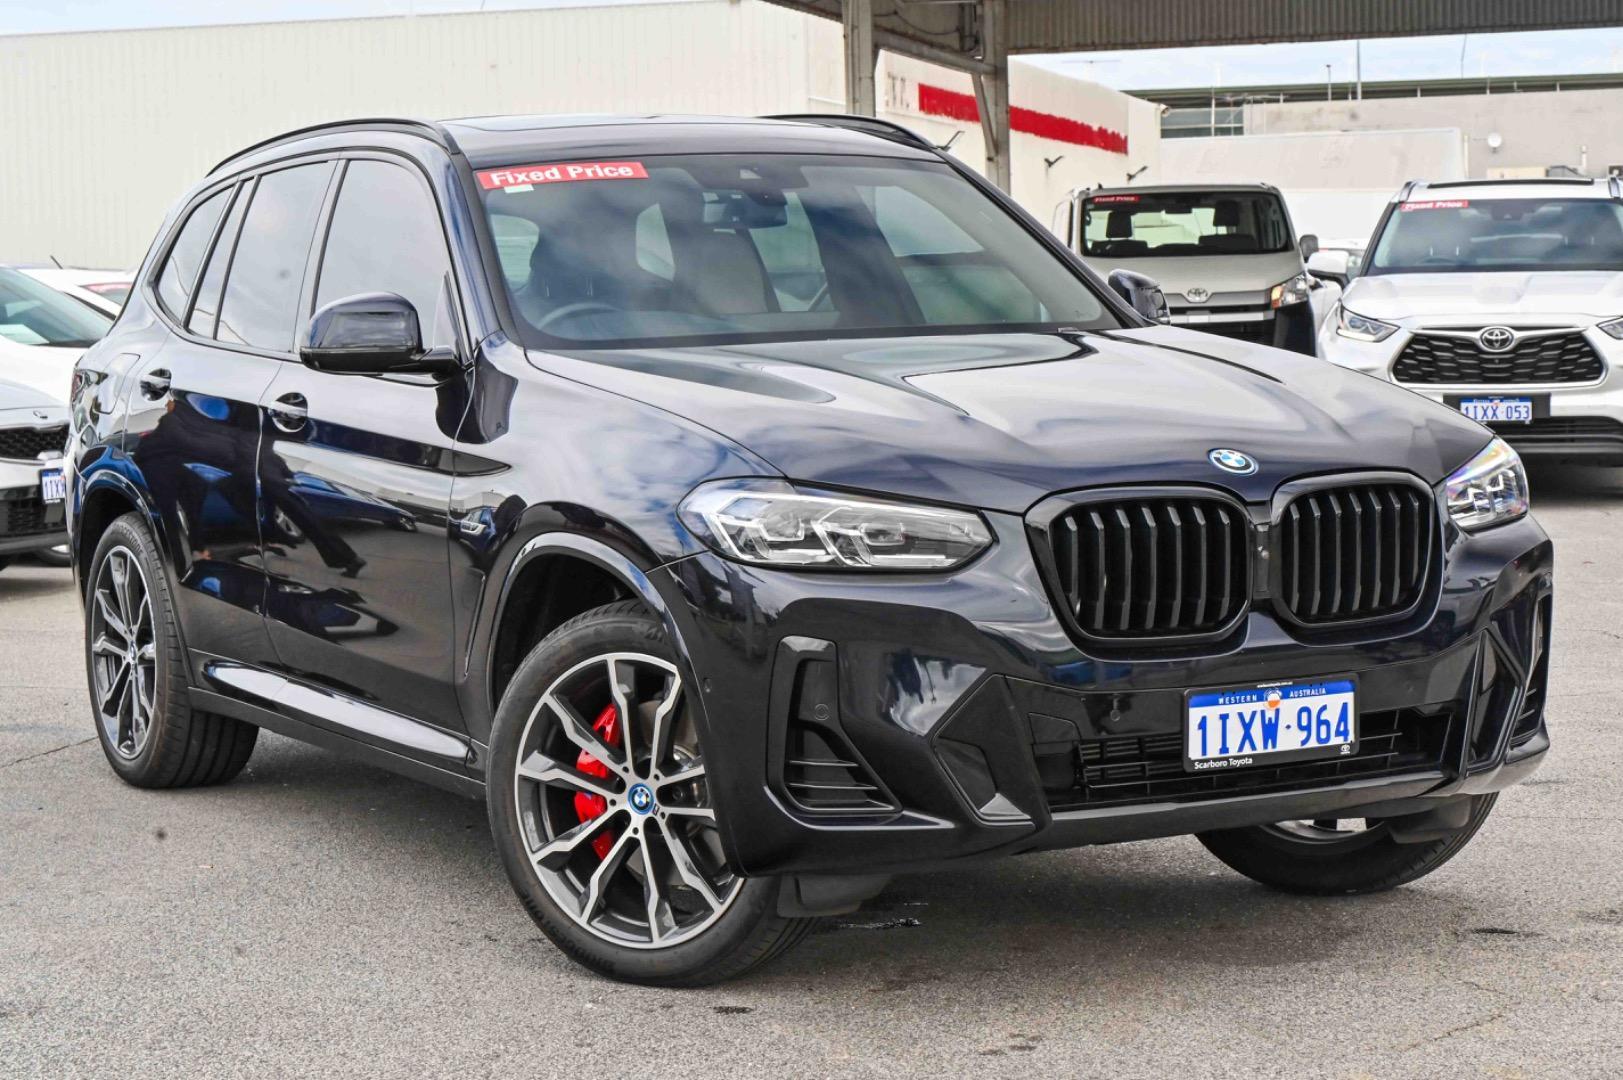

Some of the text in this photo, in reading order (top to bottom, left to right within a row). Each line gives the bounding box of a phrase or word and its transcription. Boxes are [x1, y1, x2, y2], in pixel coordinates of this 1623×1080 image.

[490, 164, 634, 187] Fixed Price
[1218, 687, 1327, 704] WESTERN AUSTRALIA
[1194, 756, 1253, 770] Scarboro Toyota
